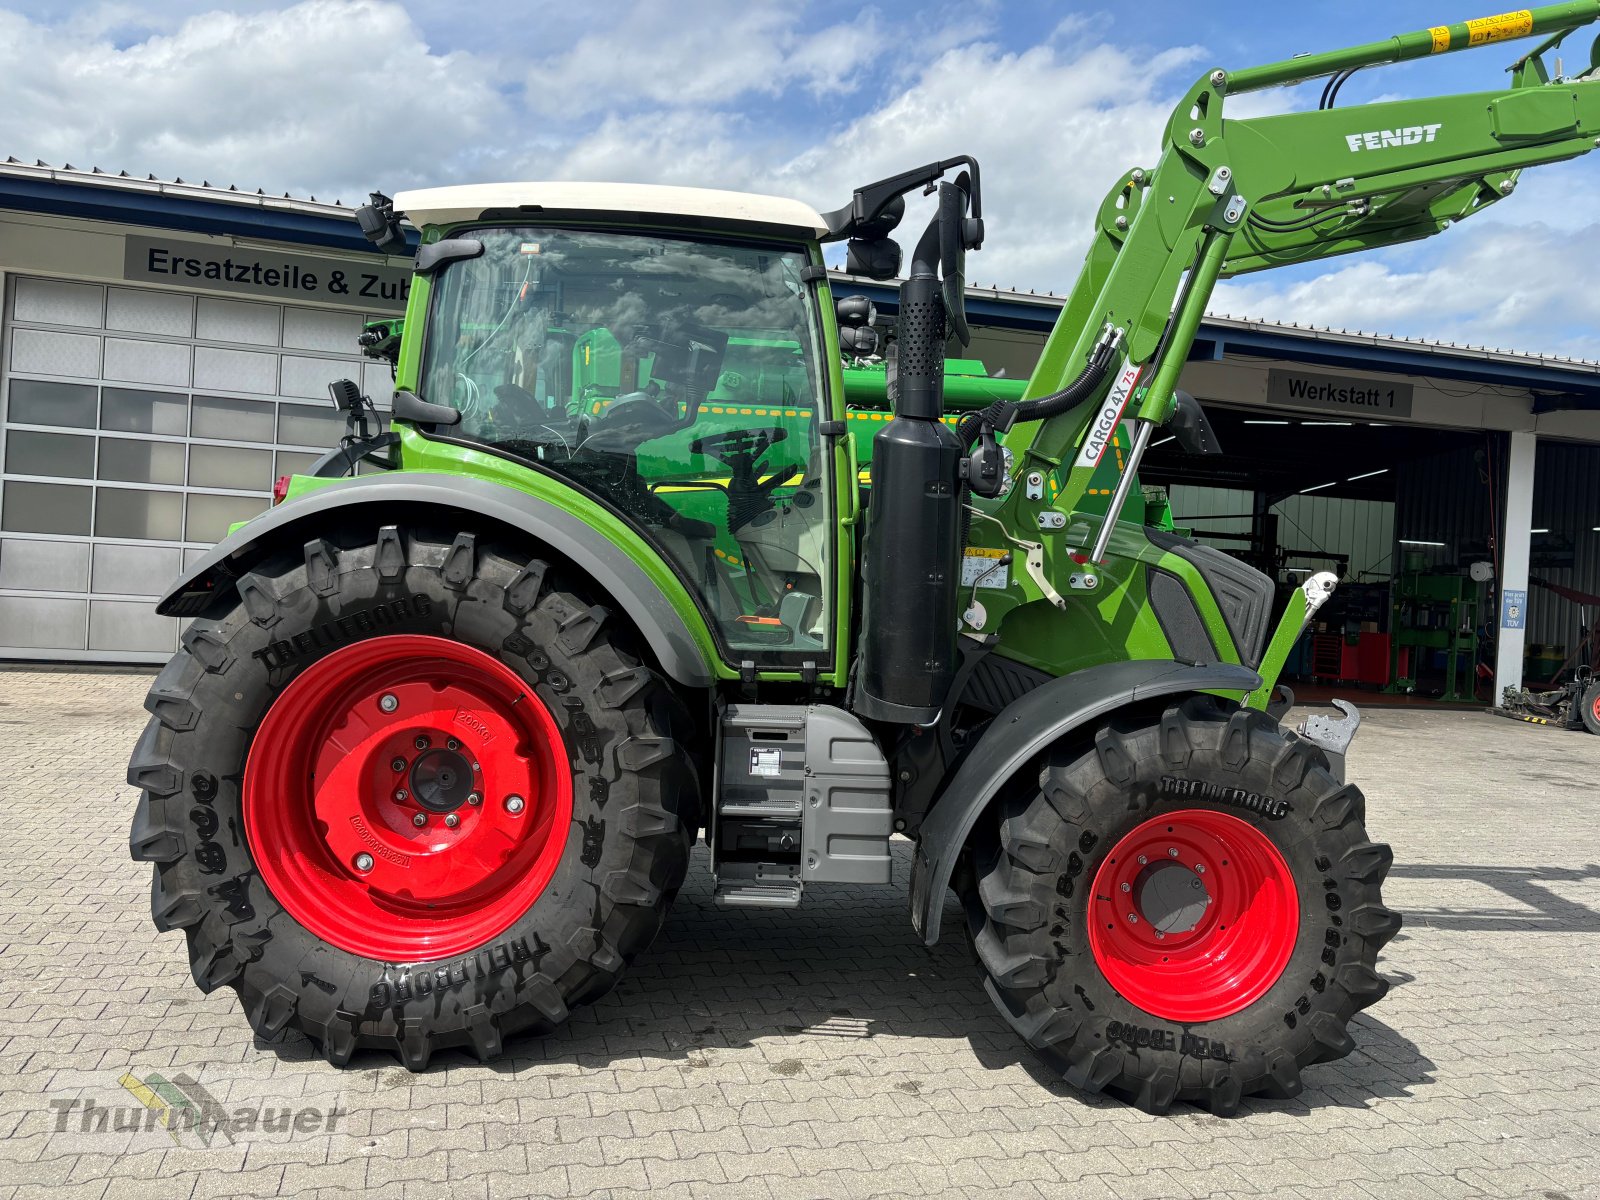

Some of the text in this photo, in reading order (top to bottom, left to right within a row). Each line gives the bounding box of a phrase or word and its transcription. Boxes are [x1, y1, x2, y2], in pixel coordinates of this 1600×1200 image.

[1345, 123, 1442, 152] FENDT
[148, 247, 318, 291] Ersatzteile
[328, 270, 350, 294] &
[1085, 370, 1136, 460] CARGO 4X 75
[1288, 378, 1395, 408] Werkstatt 1
[252, 593, 433, 671] TRELLEBORG
[1160, 776, 1289, 820] TRELLEBORG
